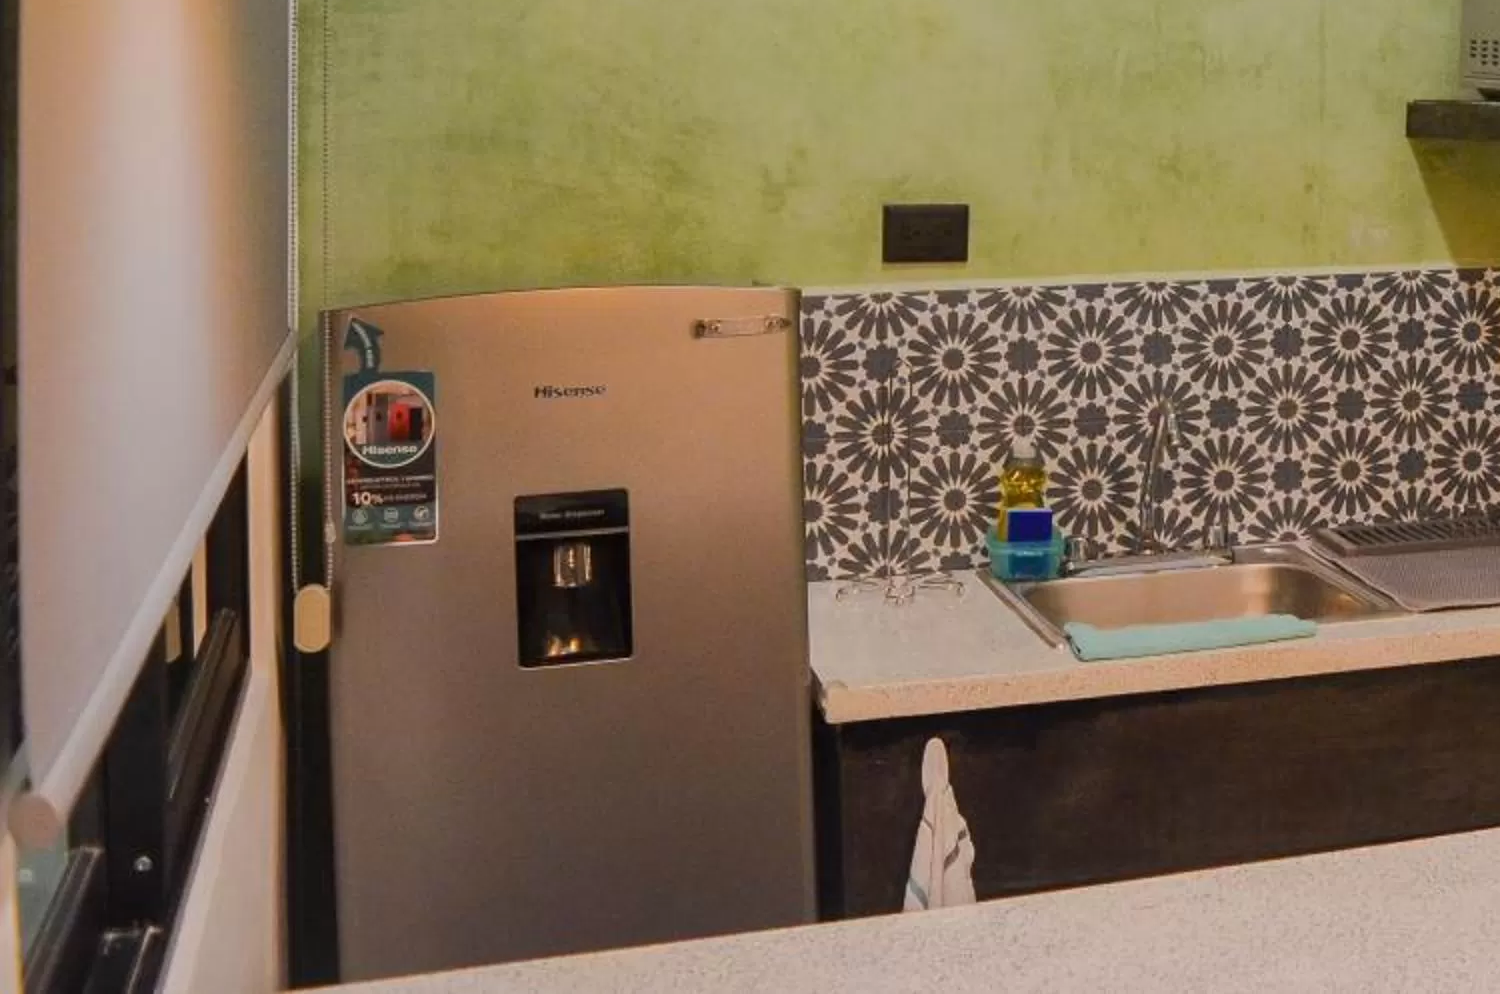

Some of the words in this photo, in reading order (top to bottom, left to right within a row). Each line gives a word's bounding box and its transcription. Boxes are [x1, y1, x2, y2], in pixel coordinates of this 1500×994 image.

[533, 384, 606, 399] Hisense
[361, 445, 418, 456] Hisense
[351, 491, 384, 505] 10%
